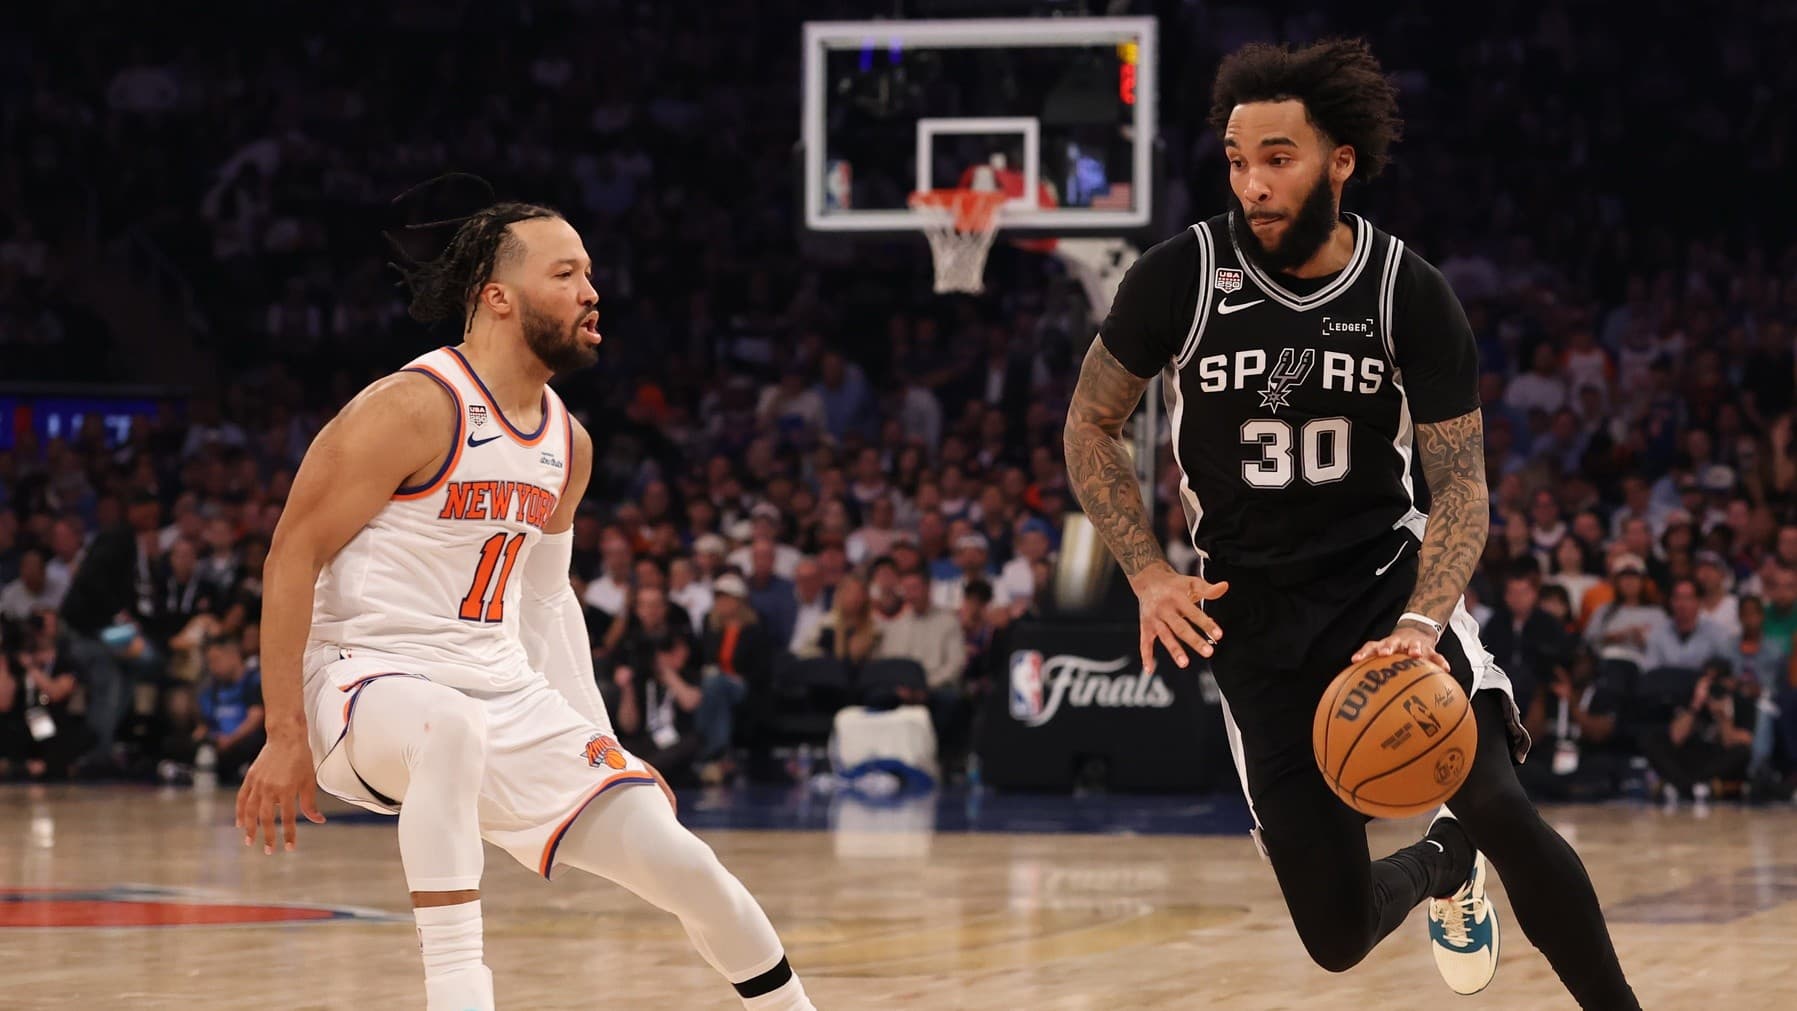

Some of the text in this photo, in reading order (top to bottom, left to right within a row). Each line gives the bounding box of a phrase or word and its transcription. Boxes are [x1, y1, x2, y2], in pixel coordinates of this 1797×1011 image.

[1328, 322, 1367, 332] LEDGER
[1240, 416, 1352, 489] 30
[438, 480, 515, 520] NEW
[458, 532, 527, 623] 11
[1024, 654, 1175, 728] Finals
[1335, 658, 1425, 722] Wilson
